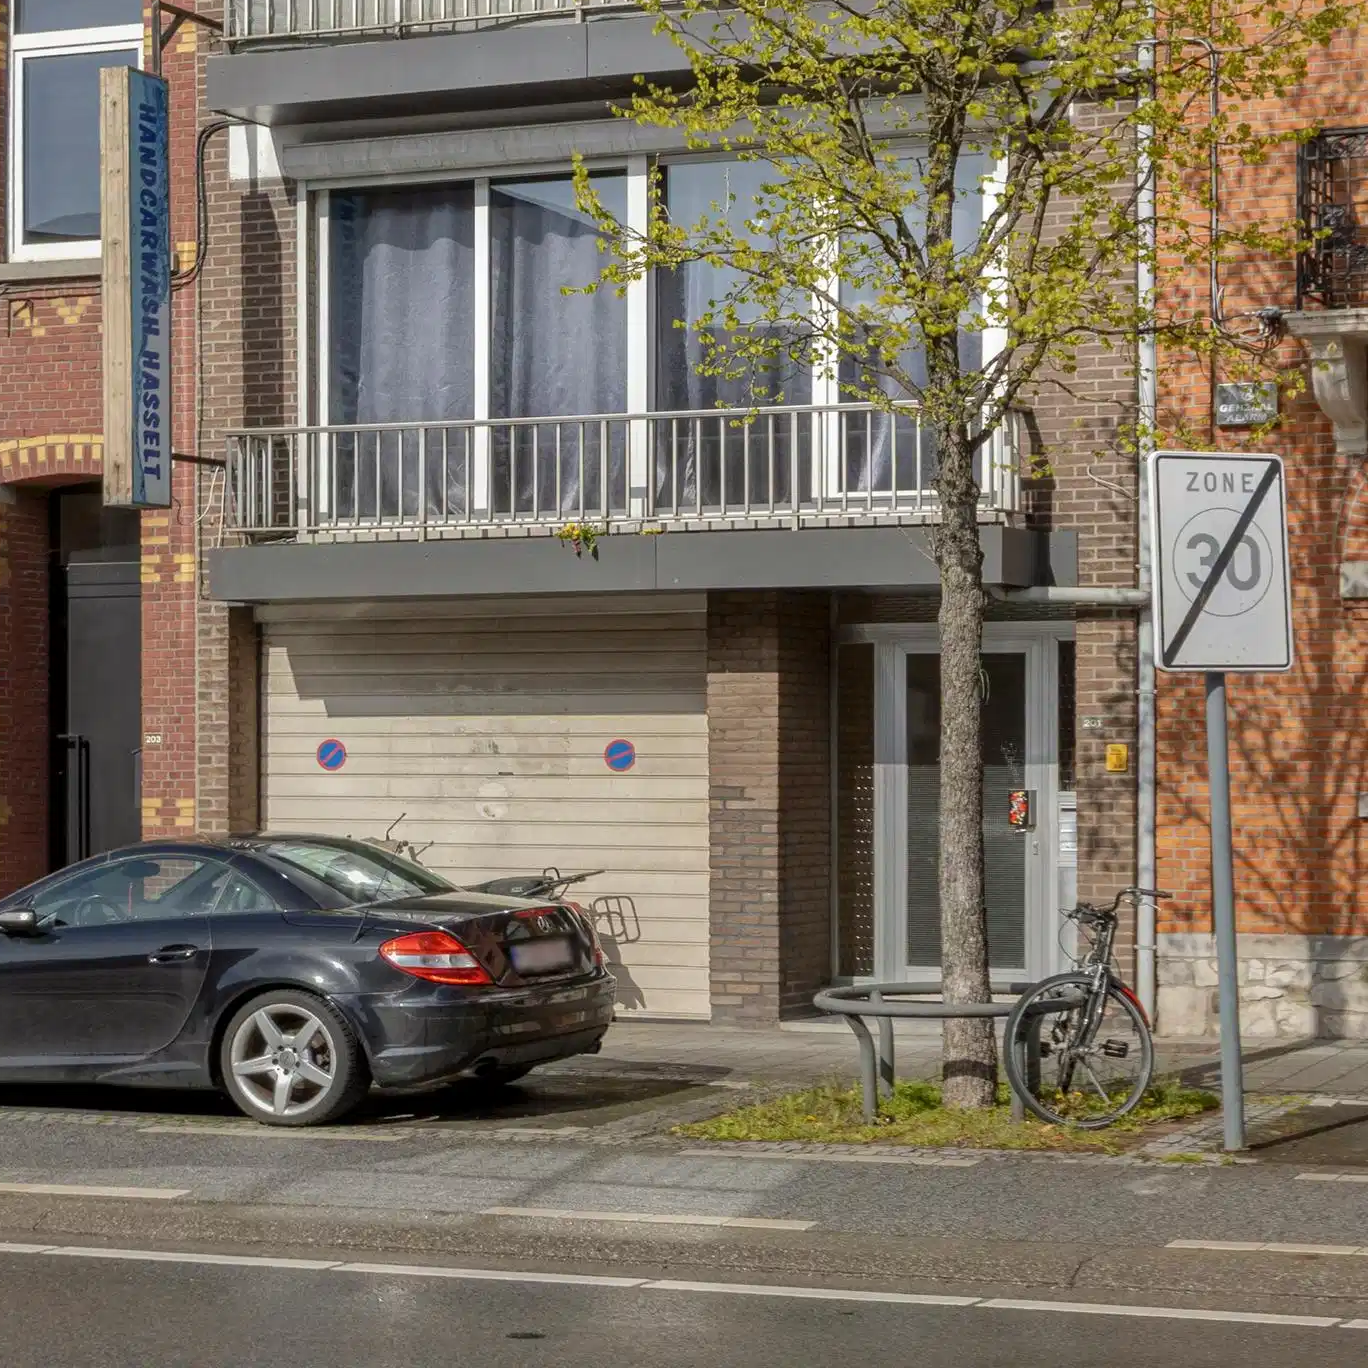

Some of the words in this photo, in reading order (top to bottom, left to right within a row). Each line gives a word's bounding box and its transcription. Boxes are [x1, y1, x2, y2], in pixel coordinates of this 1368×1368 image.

[138, 103, 160, 336] HANDCARWASH
[141, 350, 161, 480] HASSELT
[1185, 471, 1254, 494] ZONE
[1185, 532, 1262, 592] 30
